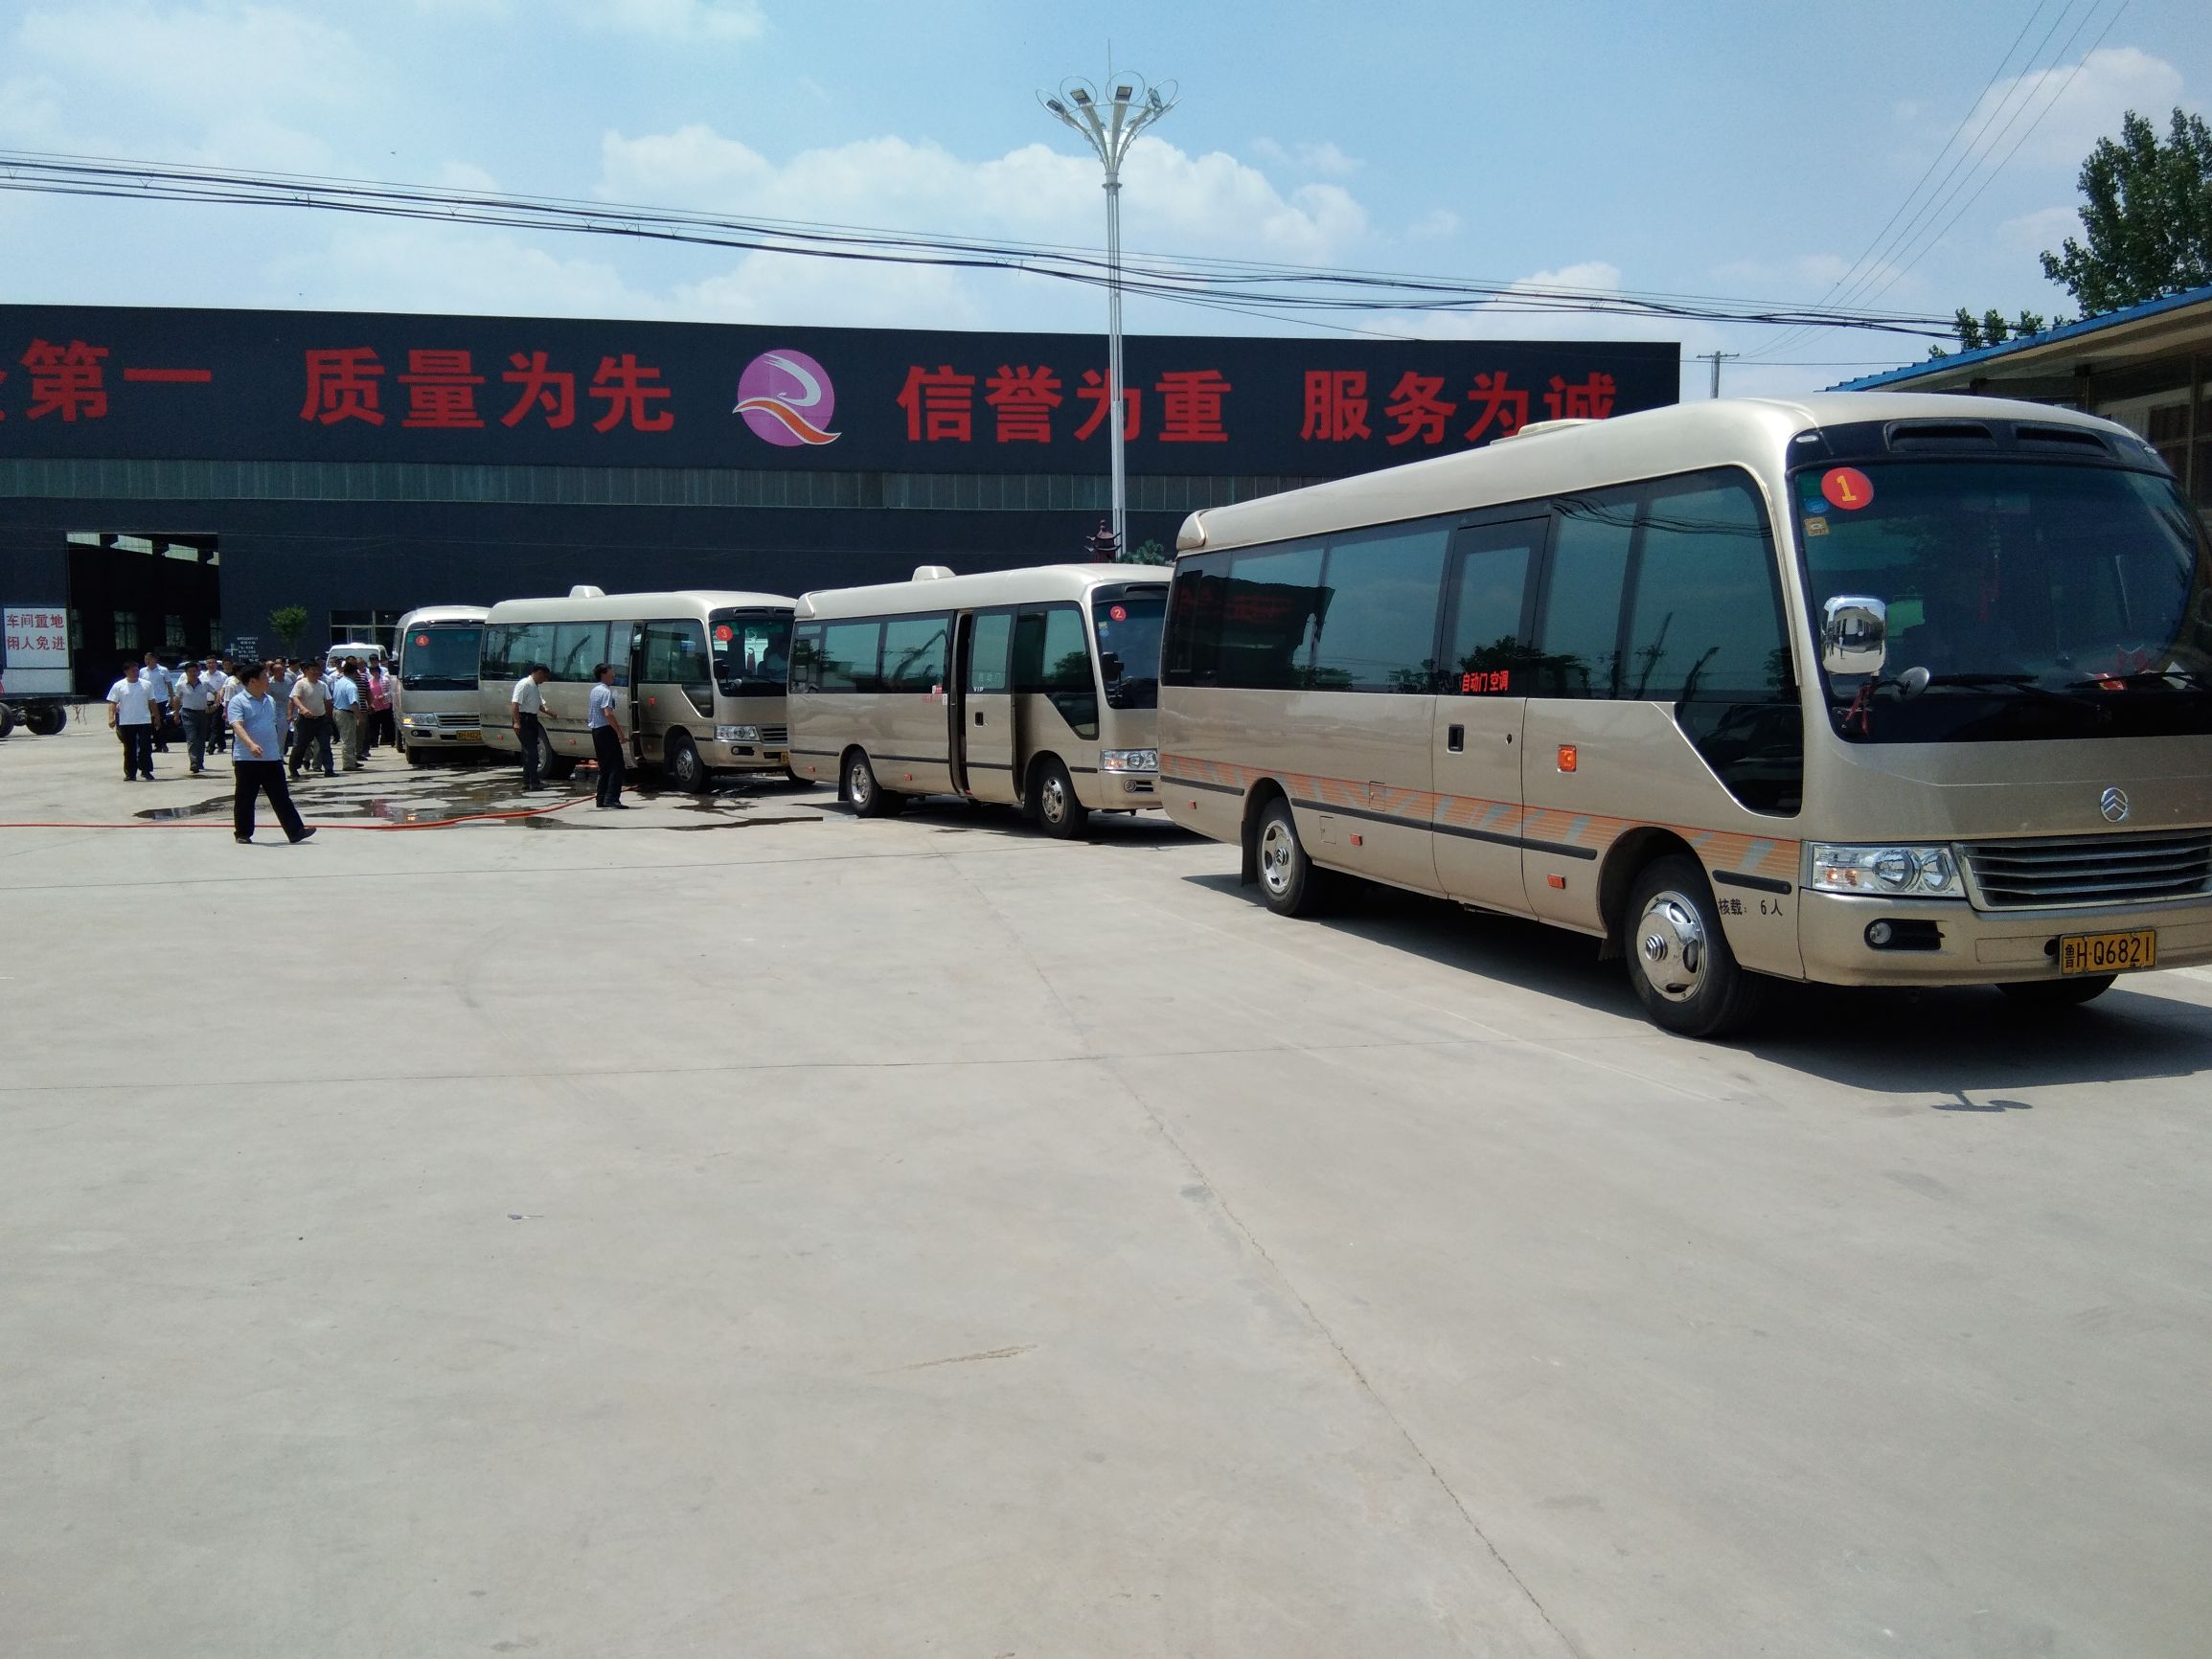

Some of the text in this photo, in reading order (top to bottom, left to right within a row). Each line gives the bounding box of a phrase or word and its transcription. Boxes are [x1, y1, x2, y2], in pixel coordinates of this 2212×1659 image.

[0, 338, 1617, 445] 第一 质量为先 信誉为重 服务为诚
[1836, 475, 1857, 501] 1
[6, 614, 64, 628] 车间重地
[1114, 608, 1123, 619] 2
[7, 636, 66, 651] 闲人免进
[1462, 670, 1510, 693] 自动门 空调
[1760, 898, 1784, 916] 6人
